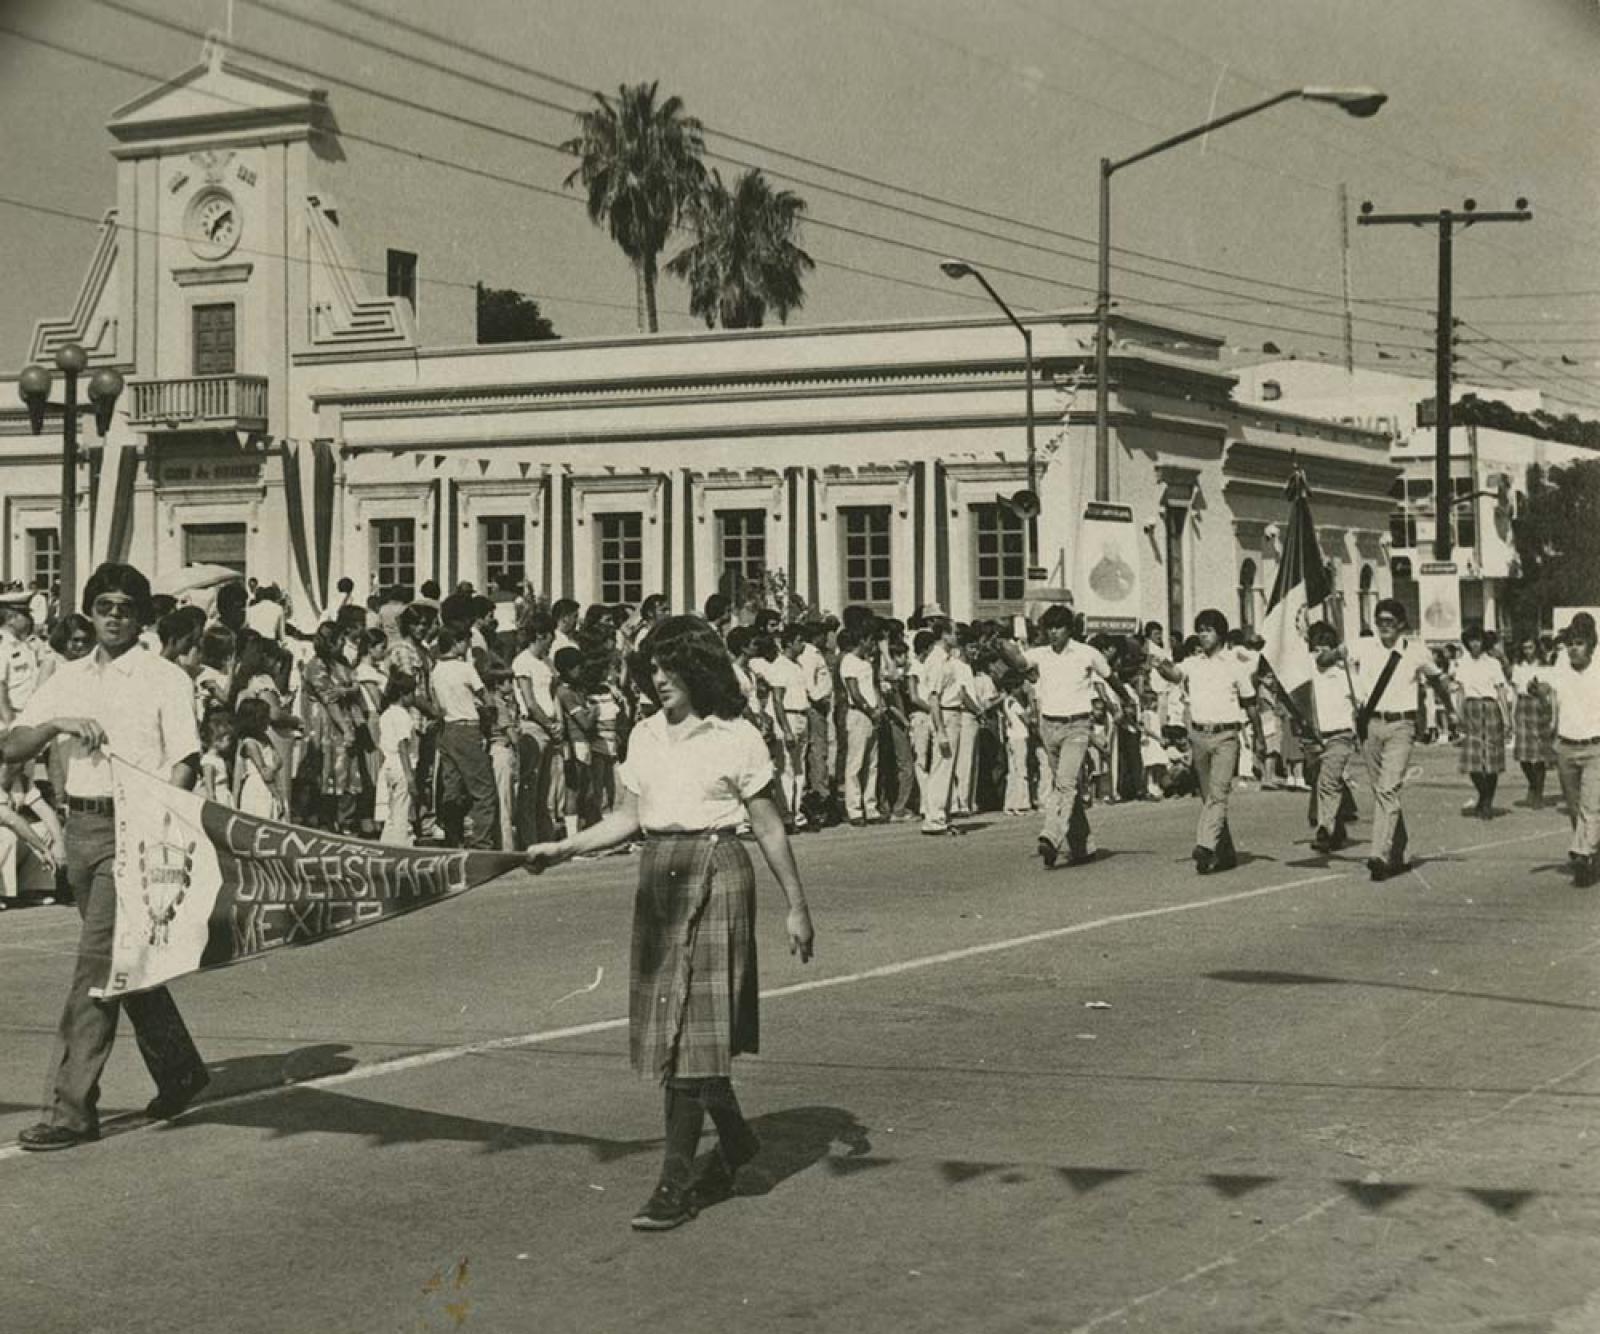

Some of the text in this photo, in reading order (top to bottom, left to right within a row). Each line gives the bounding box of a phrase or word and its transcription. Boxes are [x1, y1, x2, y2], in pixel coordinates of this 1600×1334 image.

[226, 813, 384, 857] CENTRO
[235, 851, 468, 901] UNIVERSITARIO
[231, 901, 383, 957] MEXICO
